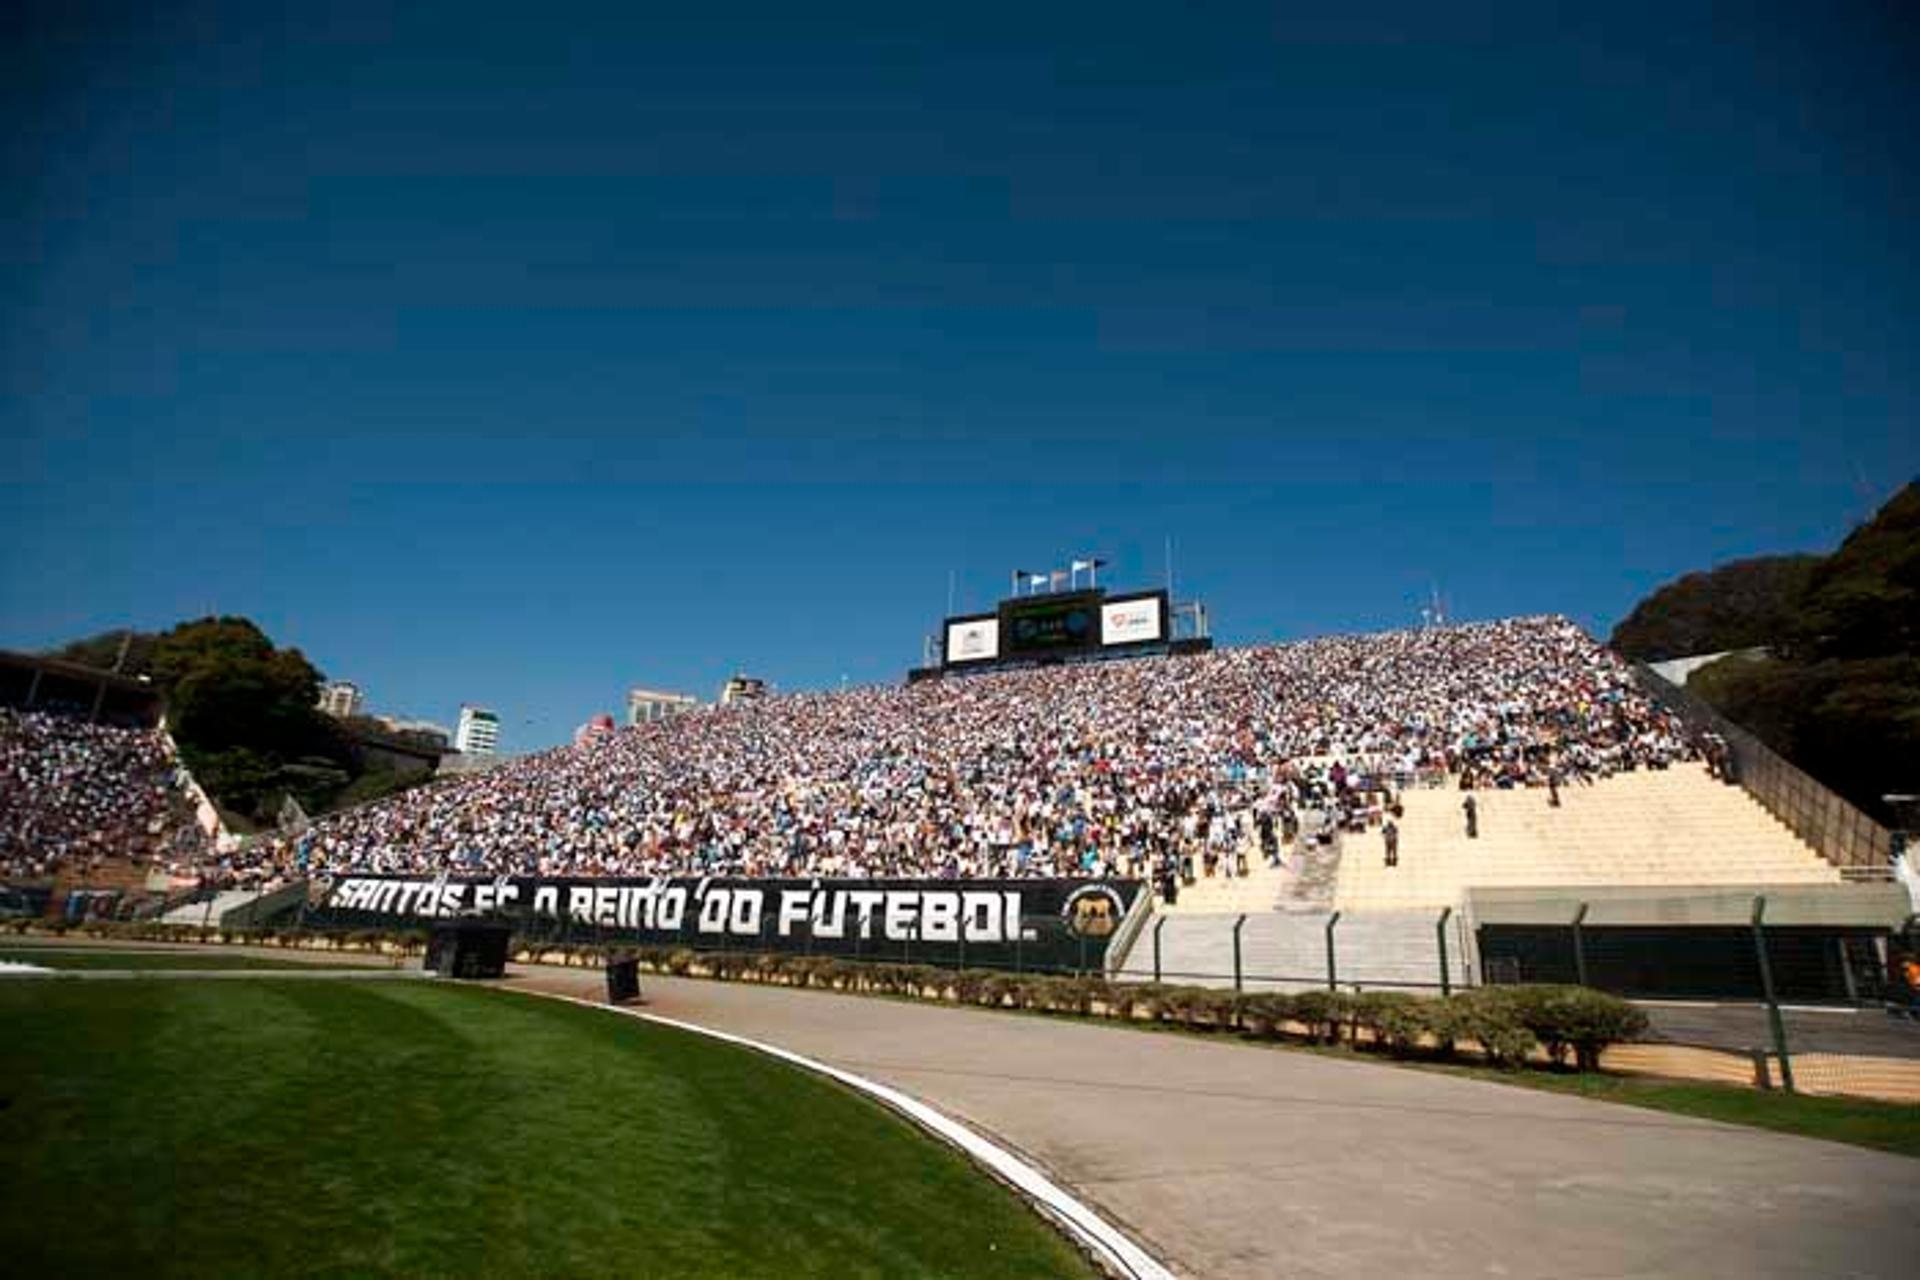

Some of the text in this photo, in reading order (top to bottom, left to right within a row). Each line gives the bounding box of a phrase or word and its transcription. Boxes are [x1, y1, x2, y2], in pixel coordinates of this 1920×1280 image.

[329, 879, 465, 917] SANTOS
[569, 887, 687, 930] REINO
[699, 889, 762, 935] DO
[778, 890, 1037, 941] FUTEBOL
